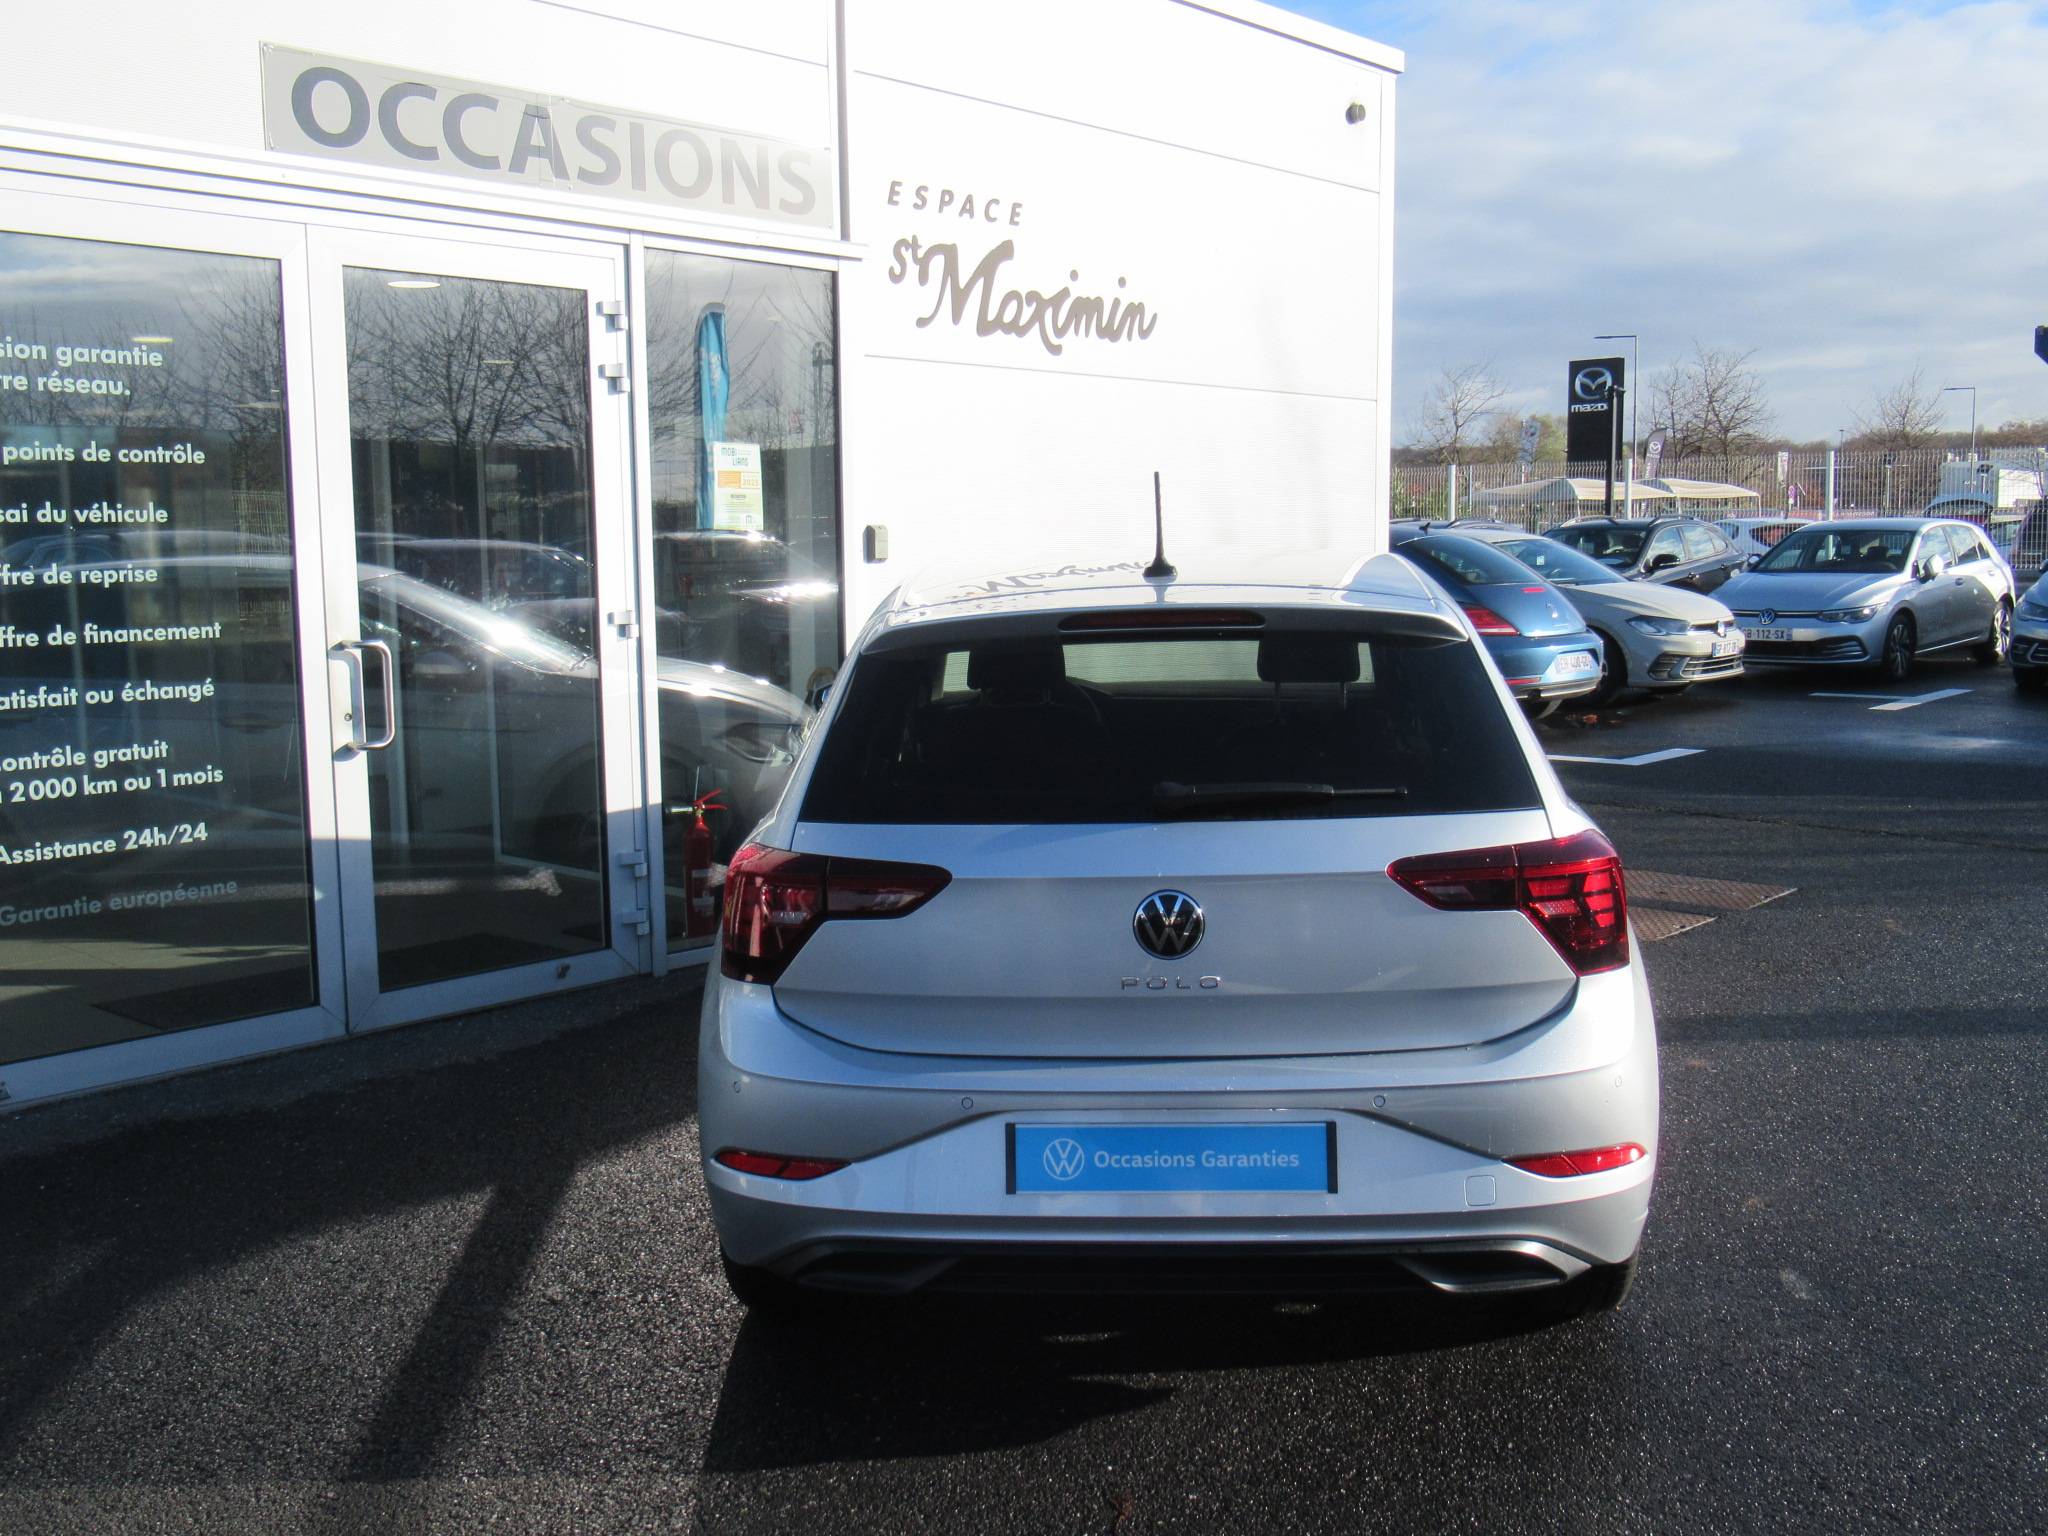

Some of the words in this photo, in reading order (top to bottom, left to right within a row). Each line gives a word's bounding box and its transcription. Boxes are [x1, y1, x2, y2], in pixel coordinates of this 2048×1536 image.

[291, 67, 816, 215] OCCASIONS
[887, 180, 1023, 226] ESPACE
[916, 239, 1157, 356] Maximin
[56, 345, 163, 367] garantie
[37, 370, 131, 396] réseau.
[3, 442, 75, 465] points
[82, 441, 111, 462] de
[118, 443, 206, 464] contrôle
[36, 502, 66, 523] du
[74, 502, 168, 523] véhicule
[43, 563, 73, 585] de
[80, 564, 158, 588] reprise
[47, 625, 77, 646] de
[83, 622, 222, 646] financement
[85, 690, 114, 705] ou
[121, 678, 215, 703] échangé
[0, 745, 86, 772] ontrôle
[93, 740, 169, 769] gratuit
[84, 775, 117, 796] km
[124, 778, 151, 791] ou
[157, 769, 167, 788] 1
[173, 765, 224, 786] mois
[0, 839, 117, 865] Assistance
[123, 822, 208, 850] 24h/24
[0, 896, 102, 927] Garantie
[109, 879, 238, 912] européenne
[1121, 975, 1222, 990] POLO
[1094, 1150, 1196, 1169] Occasions
[1201, 1149, 1300, 1168] Garanties
